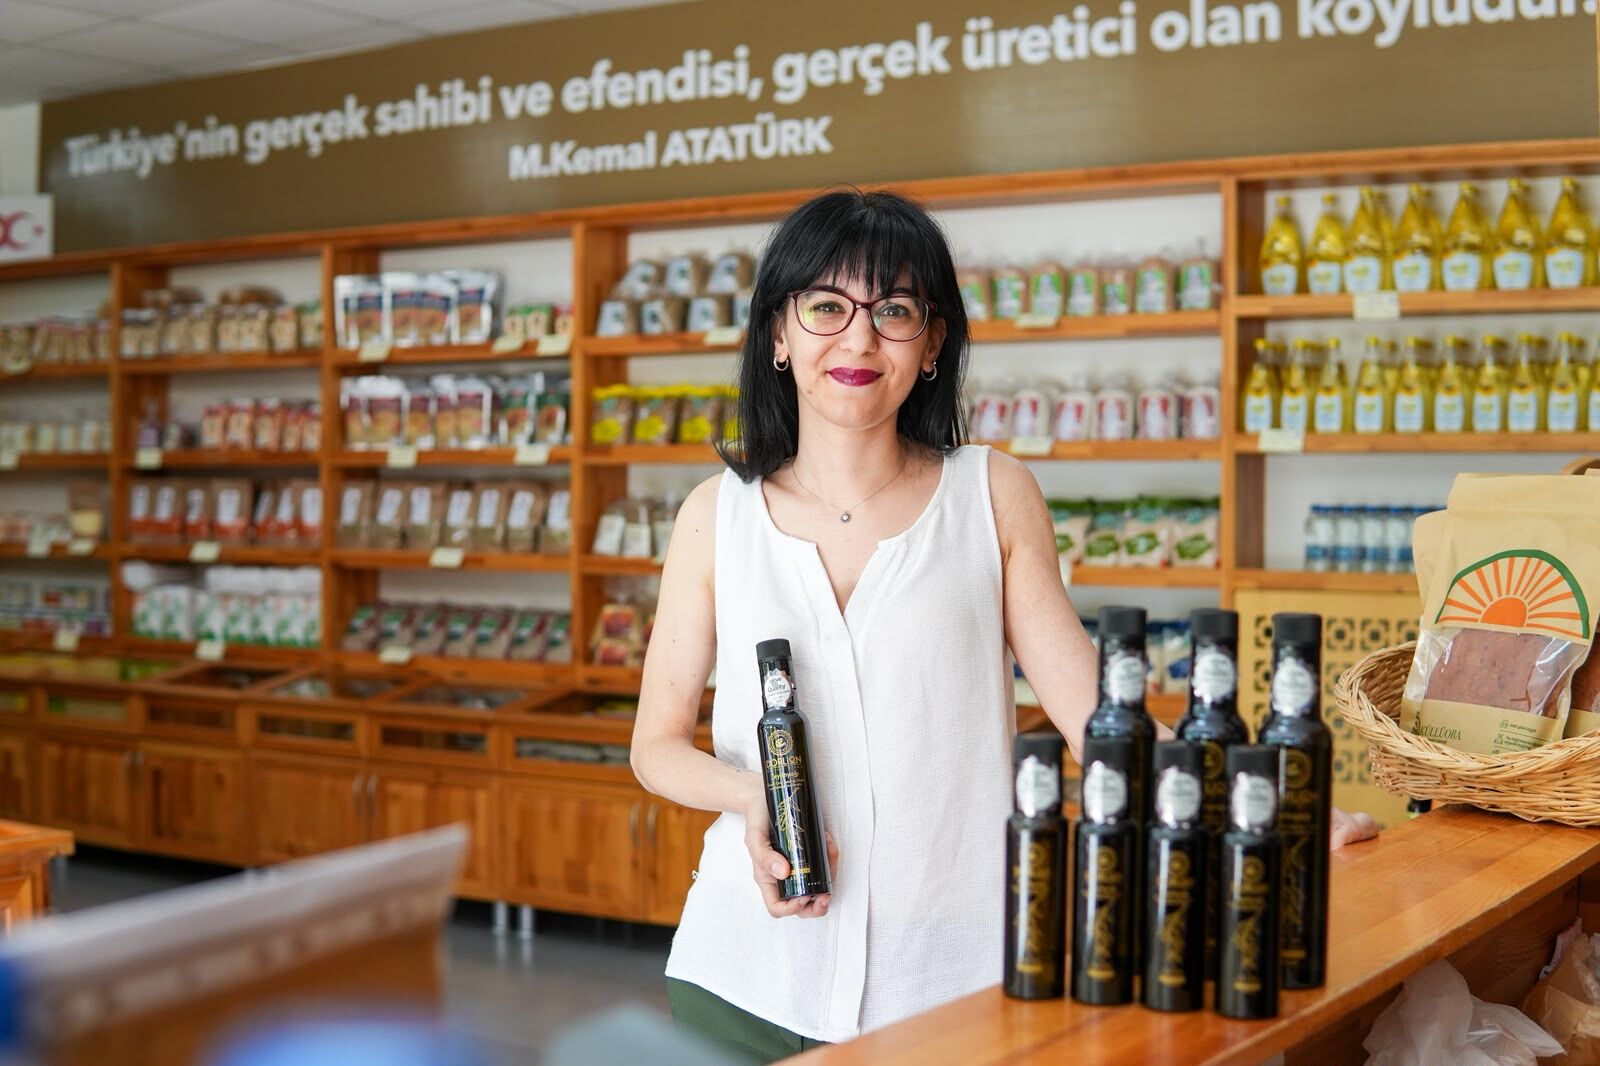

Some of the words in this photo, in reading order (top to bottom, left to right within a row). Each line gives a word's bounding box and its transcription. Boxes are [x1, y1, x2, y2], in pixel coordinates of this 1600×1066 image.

[65, 124, 239, 180] Türkiye'nin
[245, 94, 369, 164] gerçek
[374, 75, 492, 136] sahibi
[496, 80, 554, 120] ve
[561, 43, 764, 113] efendisi,
[772, 21, 952, 104] gerçek
[961, 0, 1138, 71] üretici
[1150, 0, 1283, 52] olan
[507, 128, 657, 182] M.Kemal
[659, 111, 834, 167] ATATÜRK
